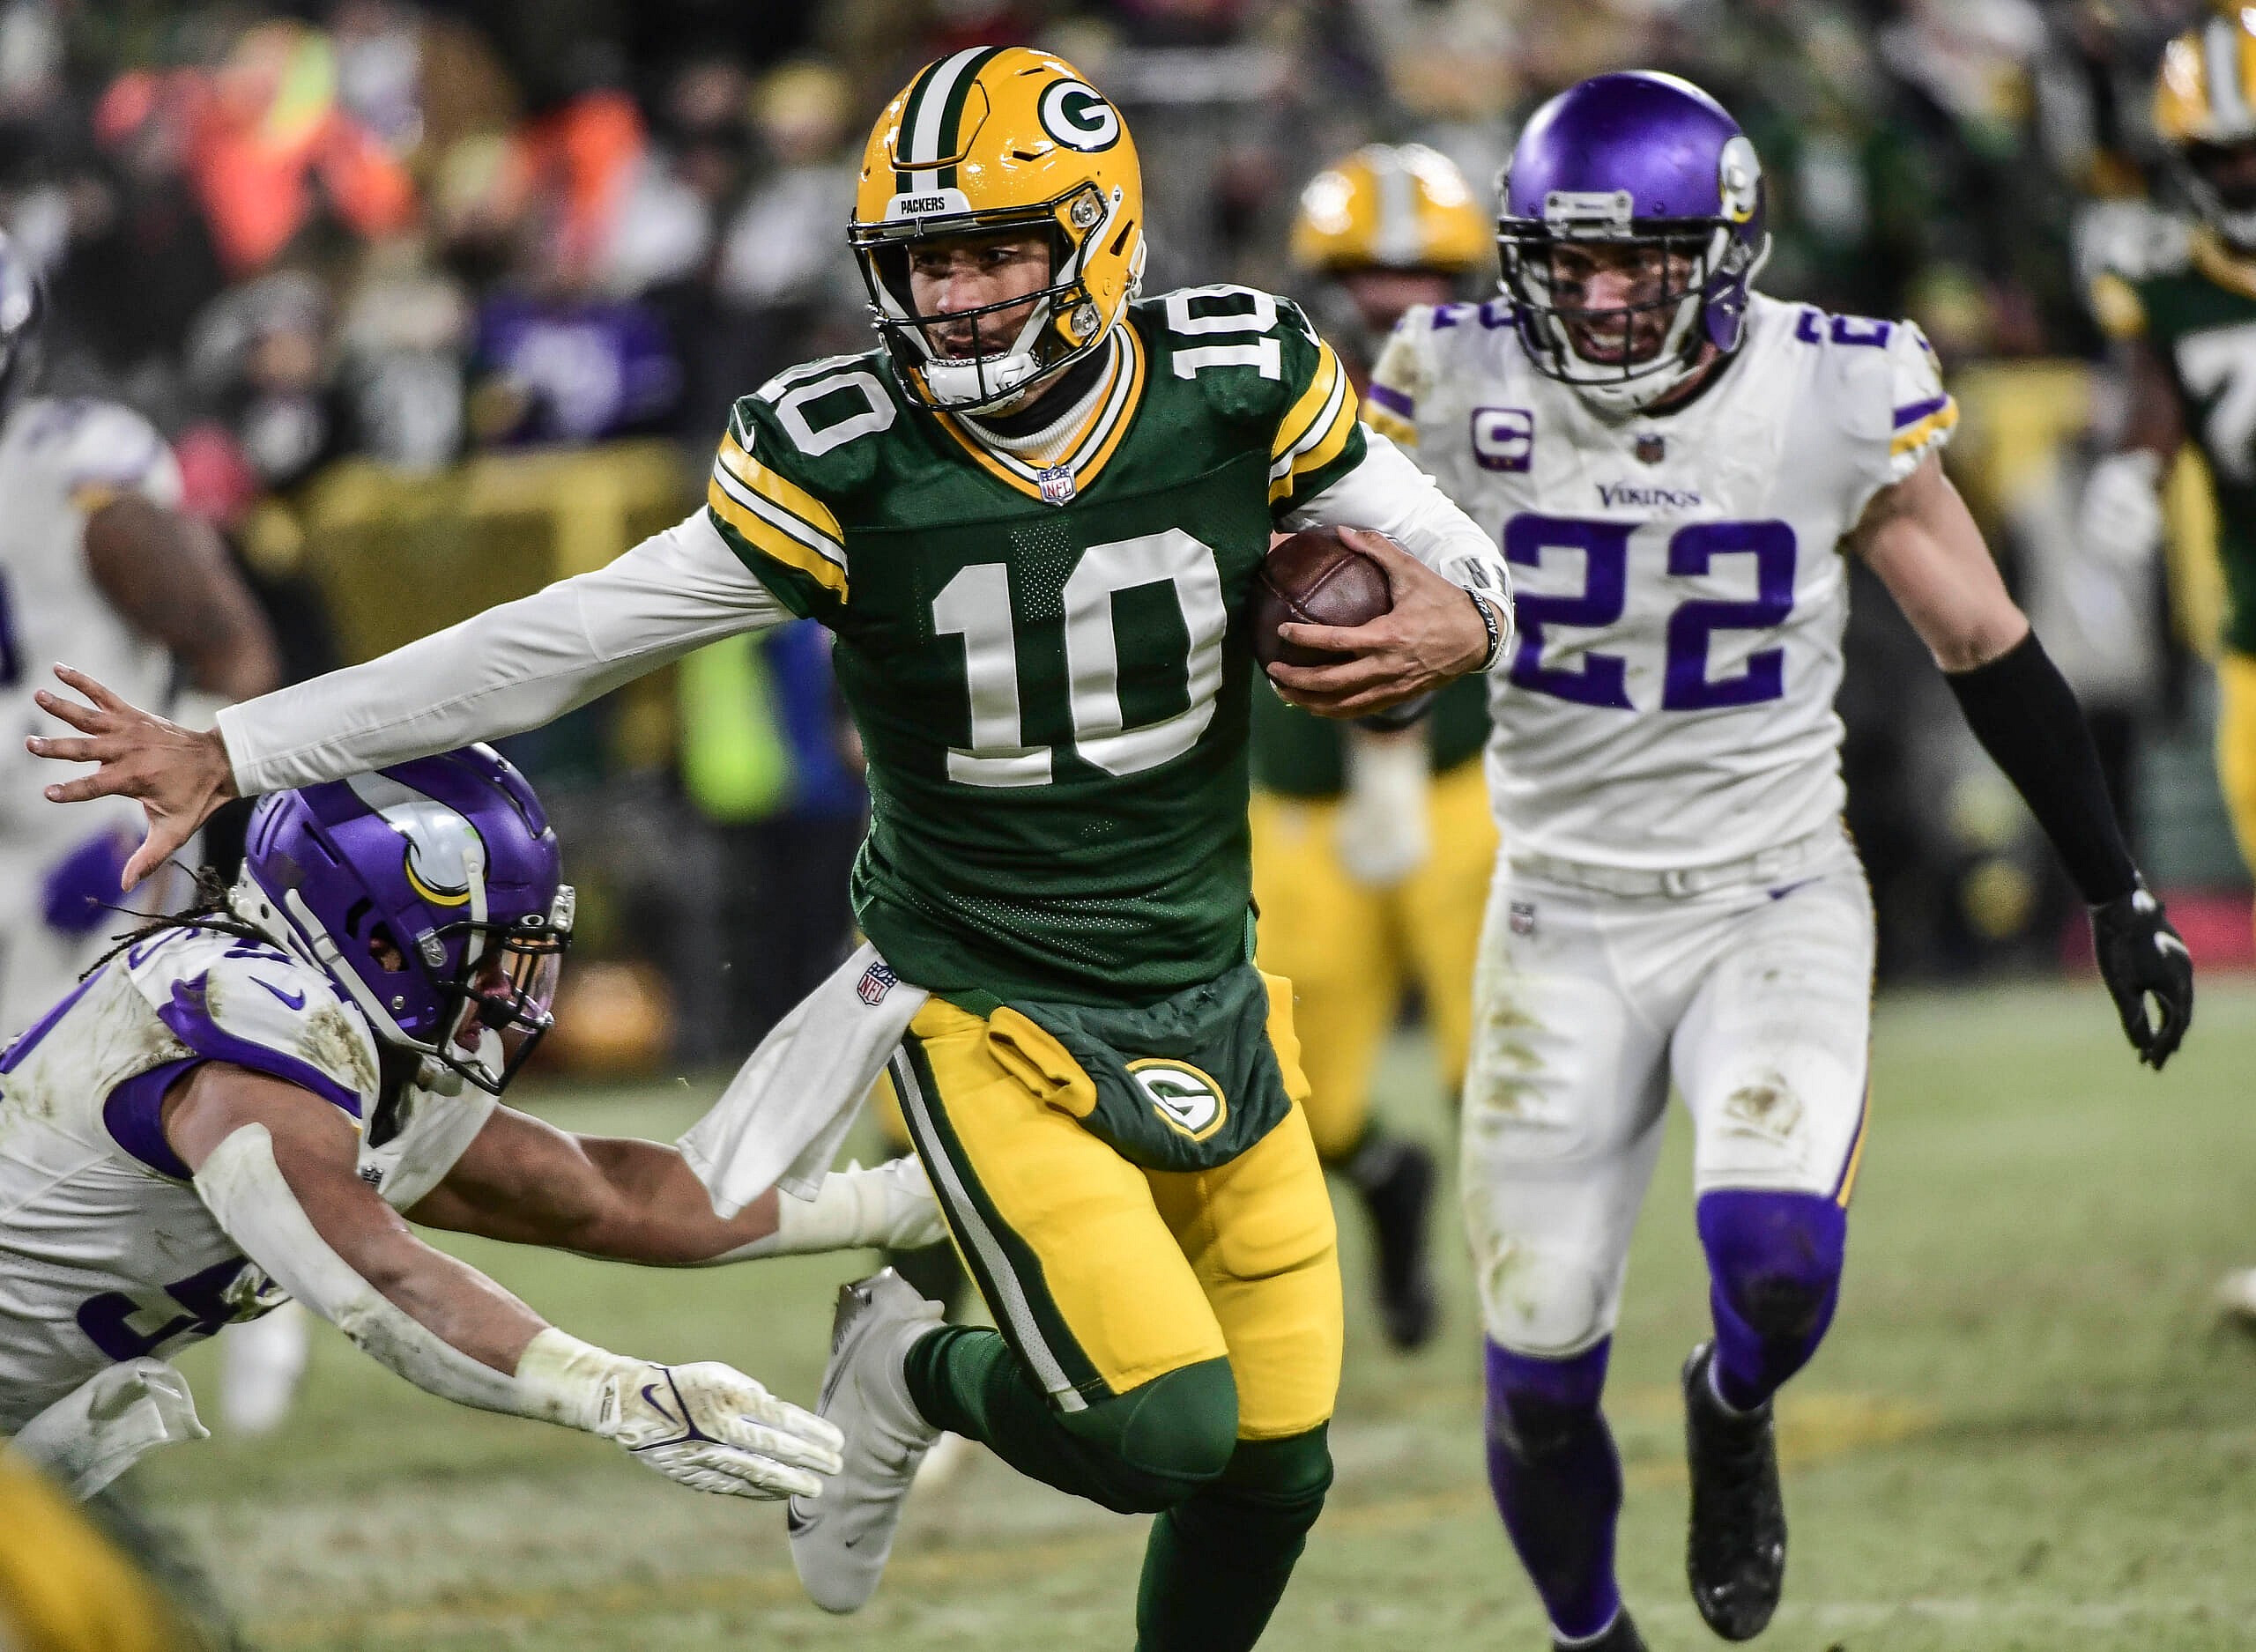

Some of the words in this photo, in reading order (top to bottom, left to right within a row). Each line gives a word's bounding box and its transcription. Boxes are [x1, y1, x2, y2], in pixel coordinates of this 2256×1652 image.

[1040, 78, 1119, 151] G
[901, 196, 945, 214] PACKERS
[1165, 284, 1280, 380] 10
[1473, 409, 1532, 458] C
[1046, 480, 1072, 497] NFL
[1488, 618, 1498, 634] AM
[1503, 512, 1796, 711] 22
[931, 528, 1228, 785] 10
[858, 974, 885, 1003] NFL
